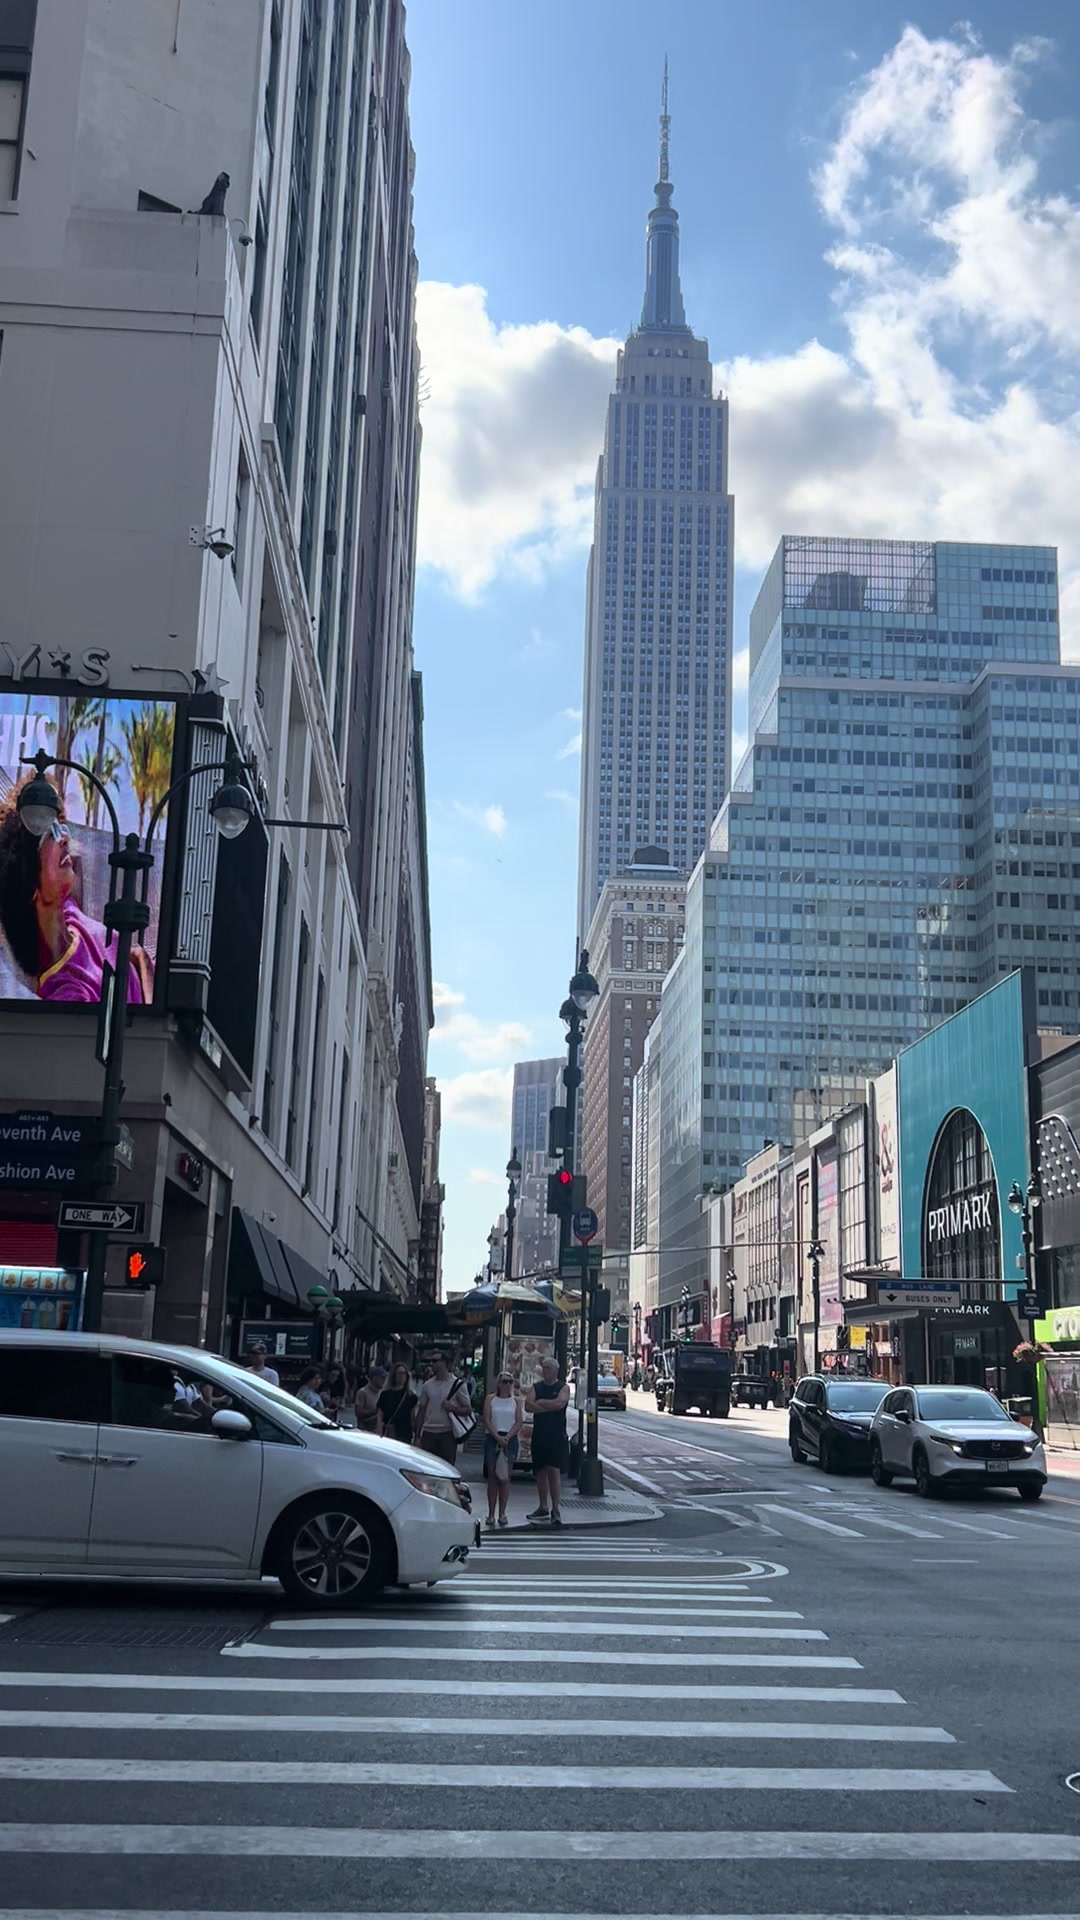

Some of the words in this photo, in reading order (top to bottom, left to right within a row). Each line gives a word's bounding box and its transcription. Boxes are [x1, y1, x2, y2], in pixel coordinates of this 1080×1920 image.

[0, 1125, 46, 1141] venth
[51, 1126, 81, 1142] Ave
[45, 1164, 76, 1180] Ave
[72, 1210, 92, 1221] ONE
[102, 1211, 125, 1223] WAY
[928, 1191, 992, 1242] PRIMARK
[905, 1294, 930, 1303] BUSES
[932, 1295, 953, 1303] ONLY
[1053, 1314, 1080, 1340] cro
